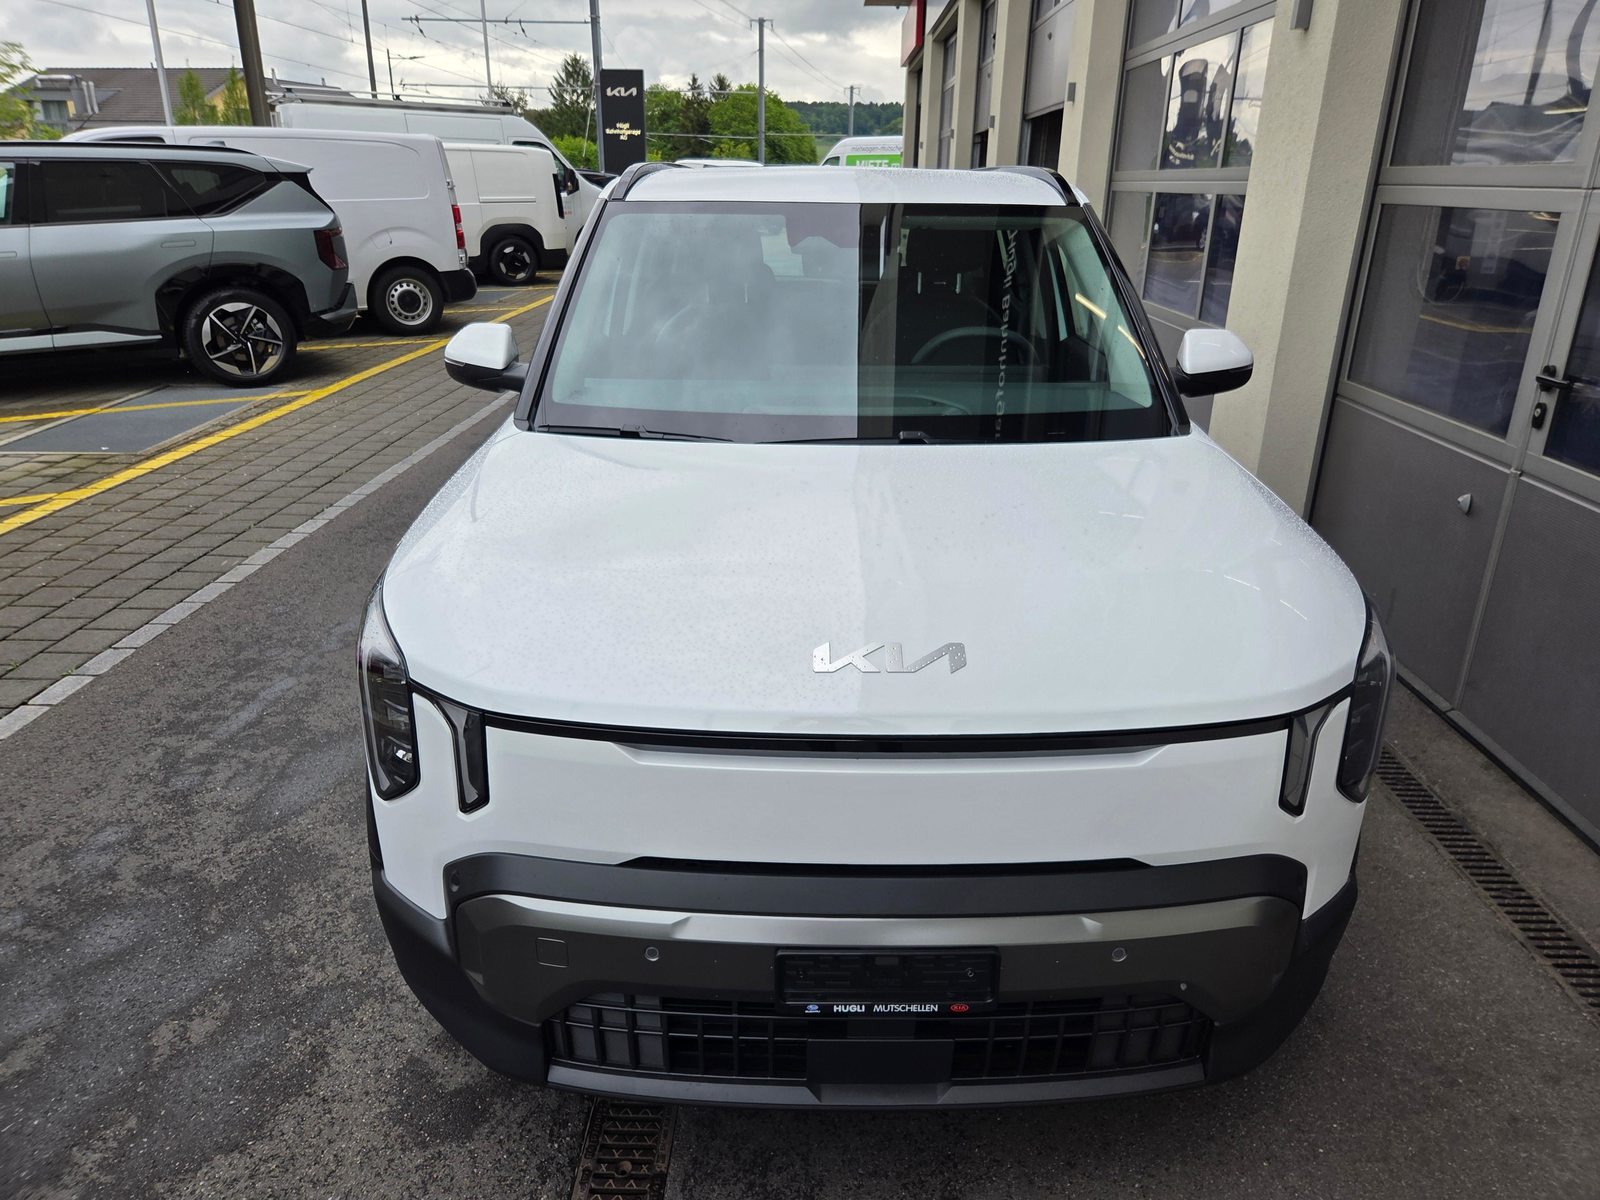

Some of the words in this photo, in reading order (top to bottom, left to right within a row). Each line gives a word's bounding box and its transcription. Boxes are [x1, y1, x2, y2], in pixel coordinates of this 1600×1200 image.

[606, 86, 637, 97] KIA
[812, 641, 967, 674] KIA
[833, 1004, 866, 1013] HUGLI
[873, 1004, 938, 1012] MUTSCHELLEN
